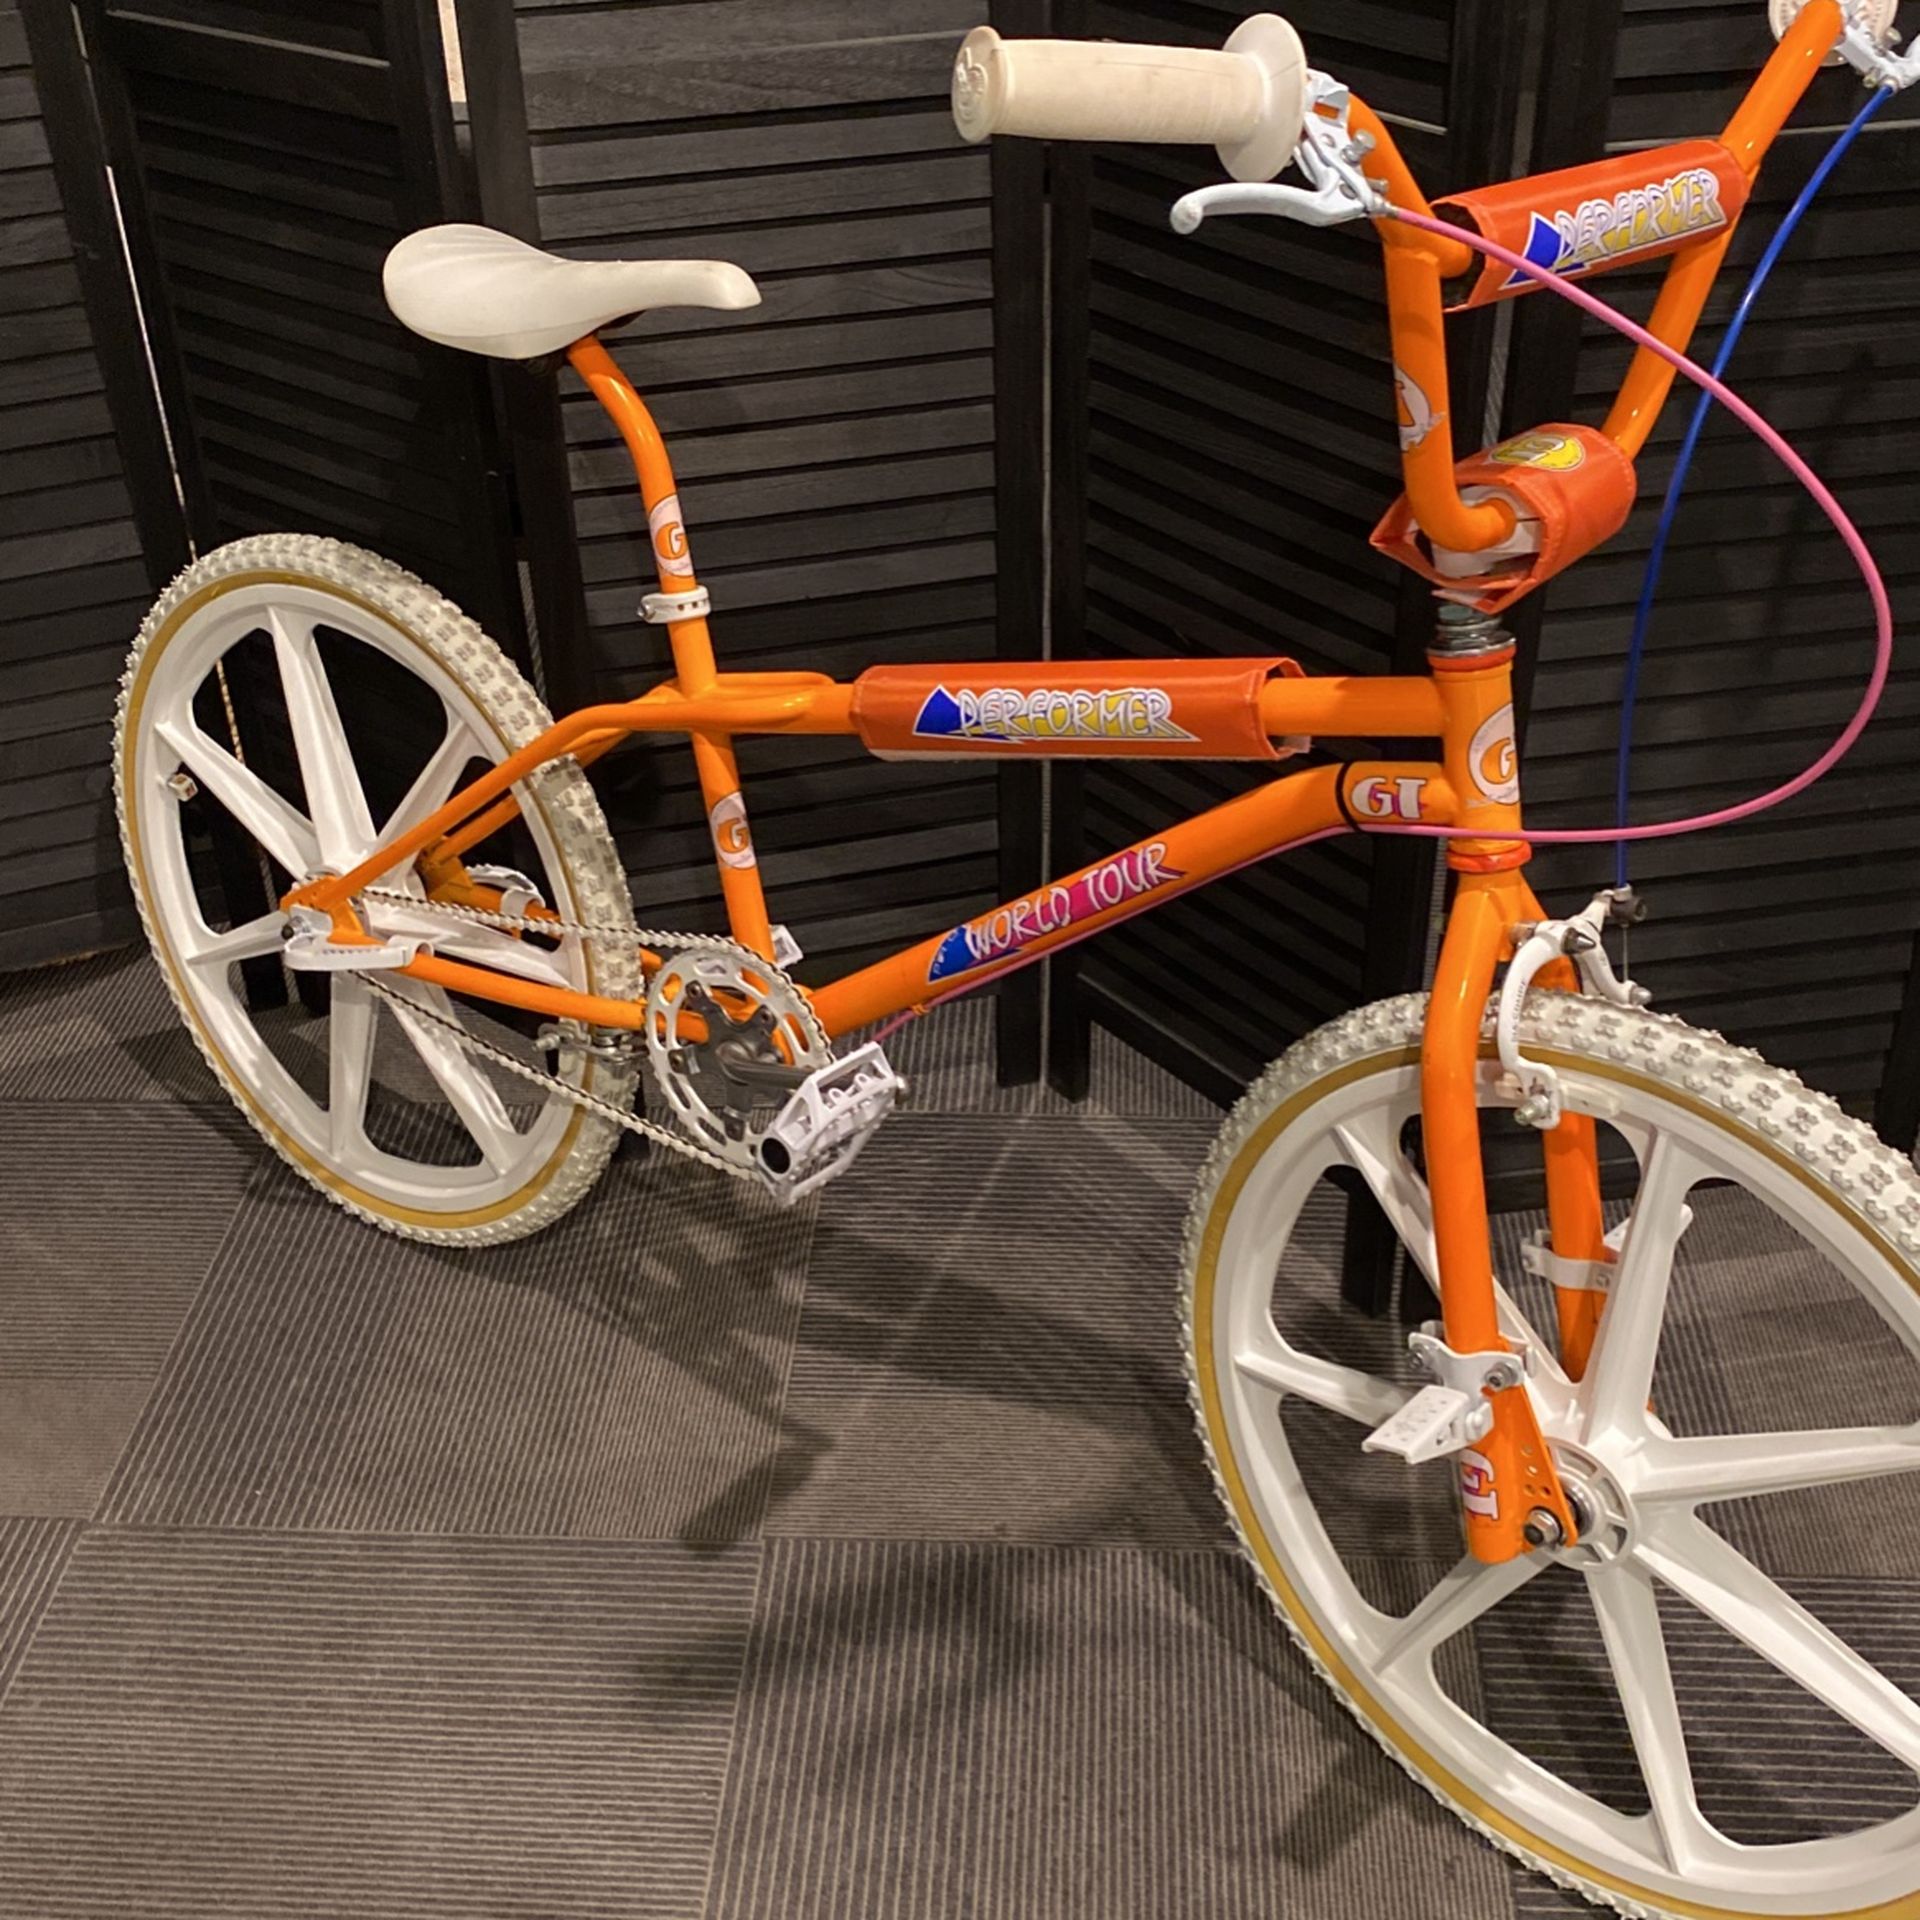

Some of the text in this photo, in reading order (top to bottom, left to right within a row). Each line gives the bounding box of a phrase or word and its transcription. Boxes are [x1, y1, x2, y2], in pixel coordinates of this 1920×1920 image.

[1553, 168, 1725, 271] PERFORMER
[958, 687, 1187, 738] PERFORMER
[1350, 777, 1429, 820] GT
[964, 886, 1072, 961] WORLD
[1081, 842, 1184, 911] TOUR
